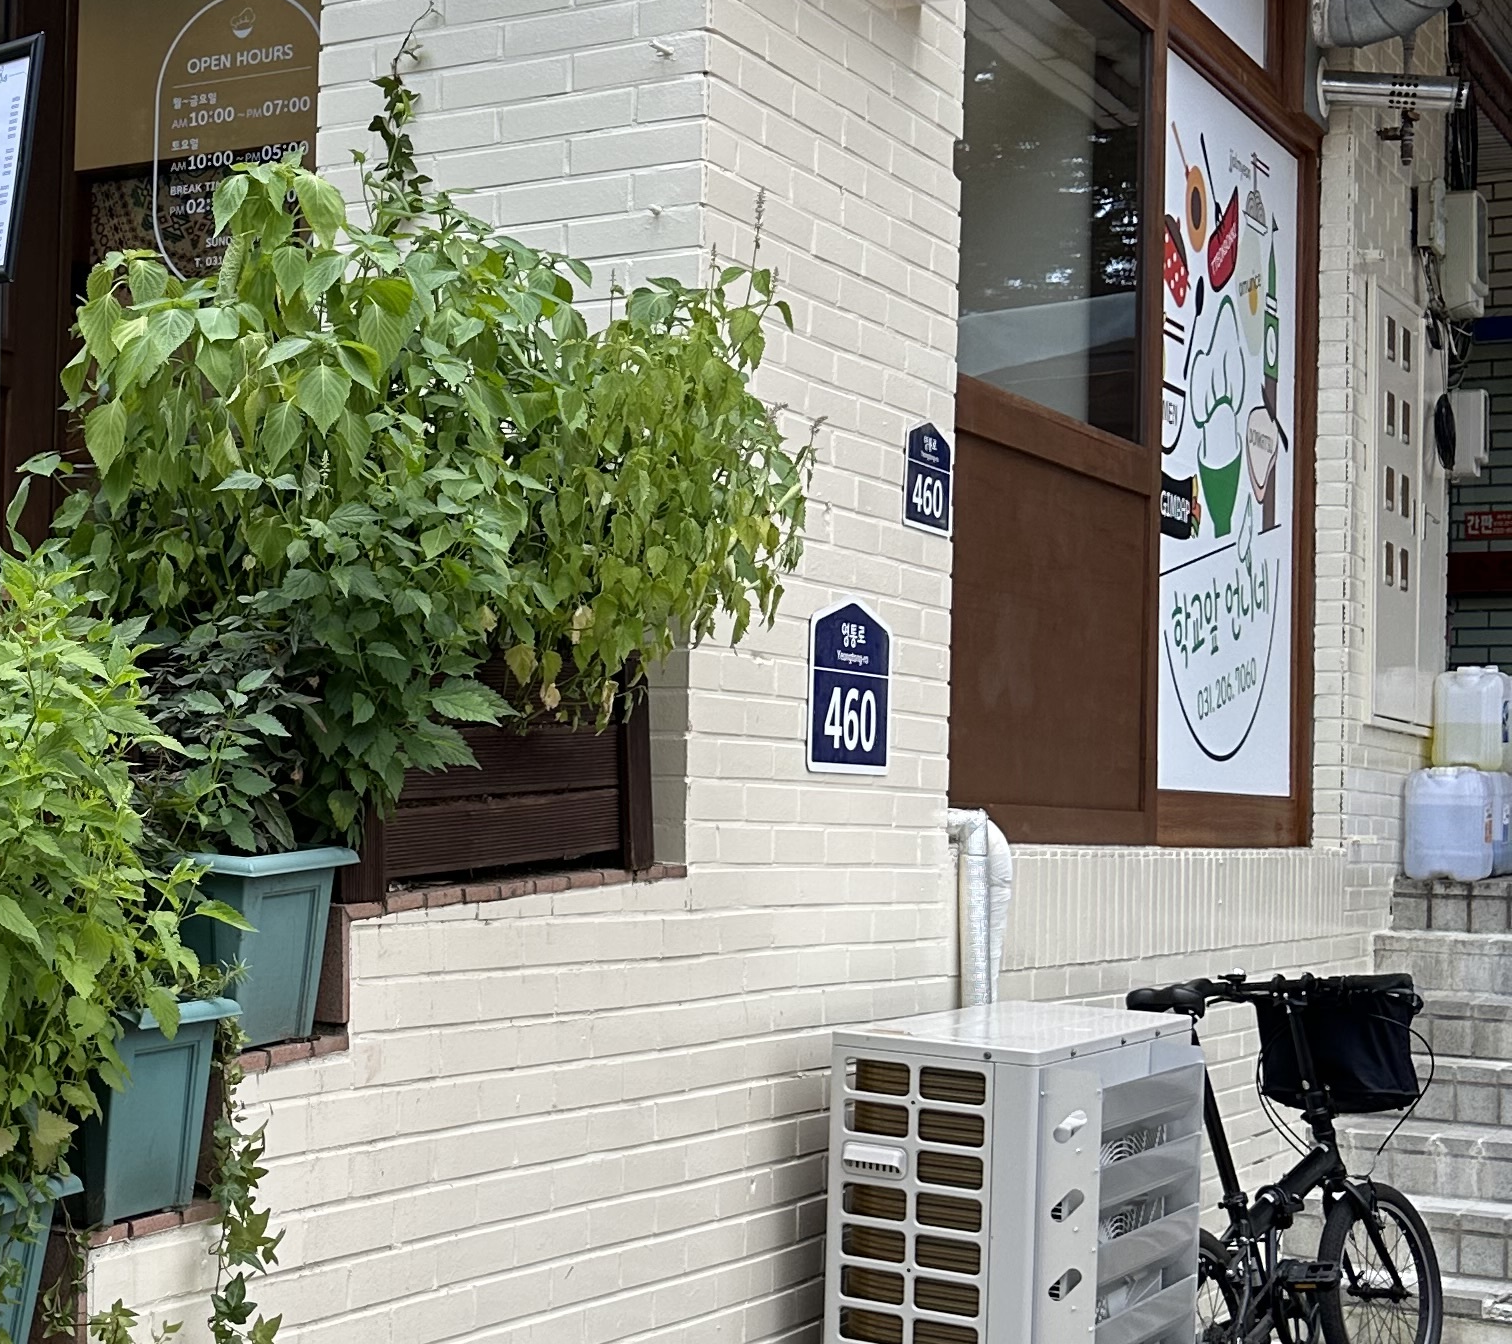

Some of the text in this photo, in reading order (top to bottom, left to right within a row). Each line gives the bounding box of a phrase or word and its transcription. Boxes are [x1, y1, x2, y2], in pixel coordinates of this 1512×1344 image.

[187, 44, 294, 74] OPEN HOURS
[170, 138, 199, 151] 토요일
[170, 181, 219, 196] BREAK TI
[912, 473, 943, 518] 460
[1467, 515, 1493, 534] 간판
[1171, 558, 1269, 669] 학교앞 언니네
[841, 622, 867, 649] 영통로
[824, 687, 877, 752] 460
